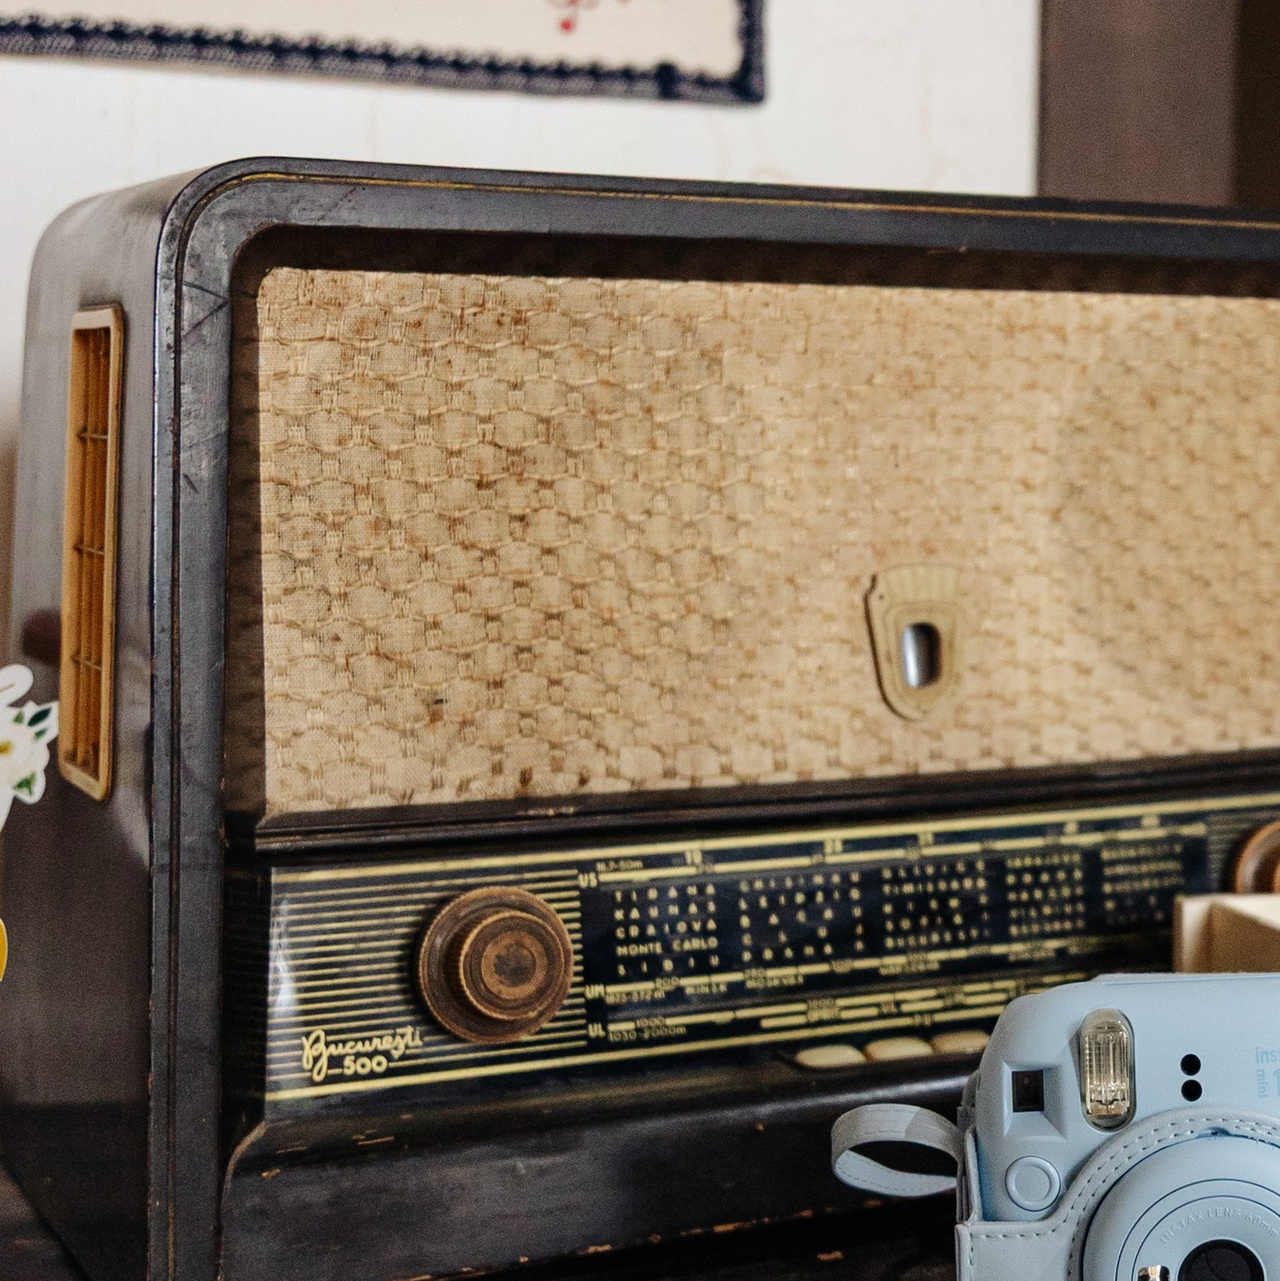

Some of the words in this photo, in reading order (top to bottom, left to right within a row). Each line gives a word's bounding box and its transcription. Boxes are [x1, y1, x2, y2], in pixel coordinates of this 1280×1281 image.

[614, 884, 716, 902] TIRANA
[614, 900, 716, 920] KAUNAS
[615, 919, 717, 939] CRAIOVA
[615, 942, 662, 956] MONTE
[672, 936, 718, 952] CARLO
[617, 955, 719, 976] SIBIU
[343, 1055, 388, 1076] 500
[1255, 1069, 1270, 1098] mini
[1159, 1211, 1203, 1244] INSTAX
[1207, 1206, 1242, 1219] LENS
[1244, 1212, 1280, 1239] 60mm
